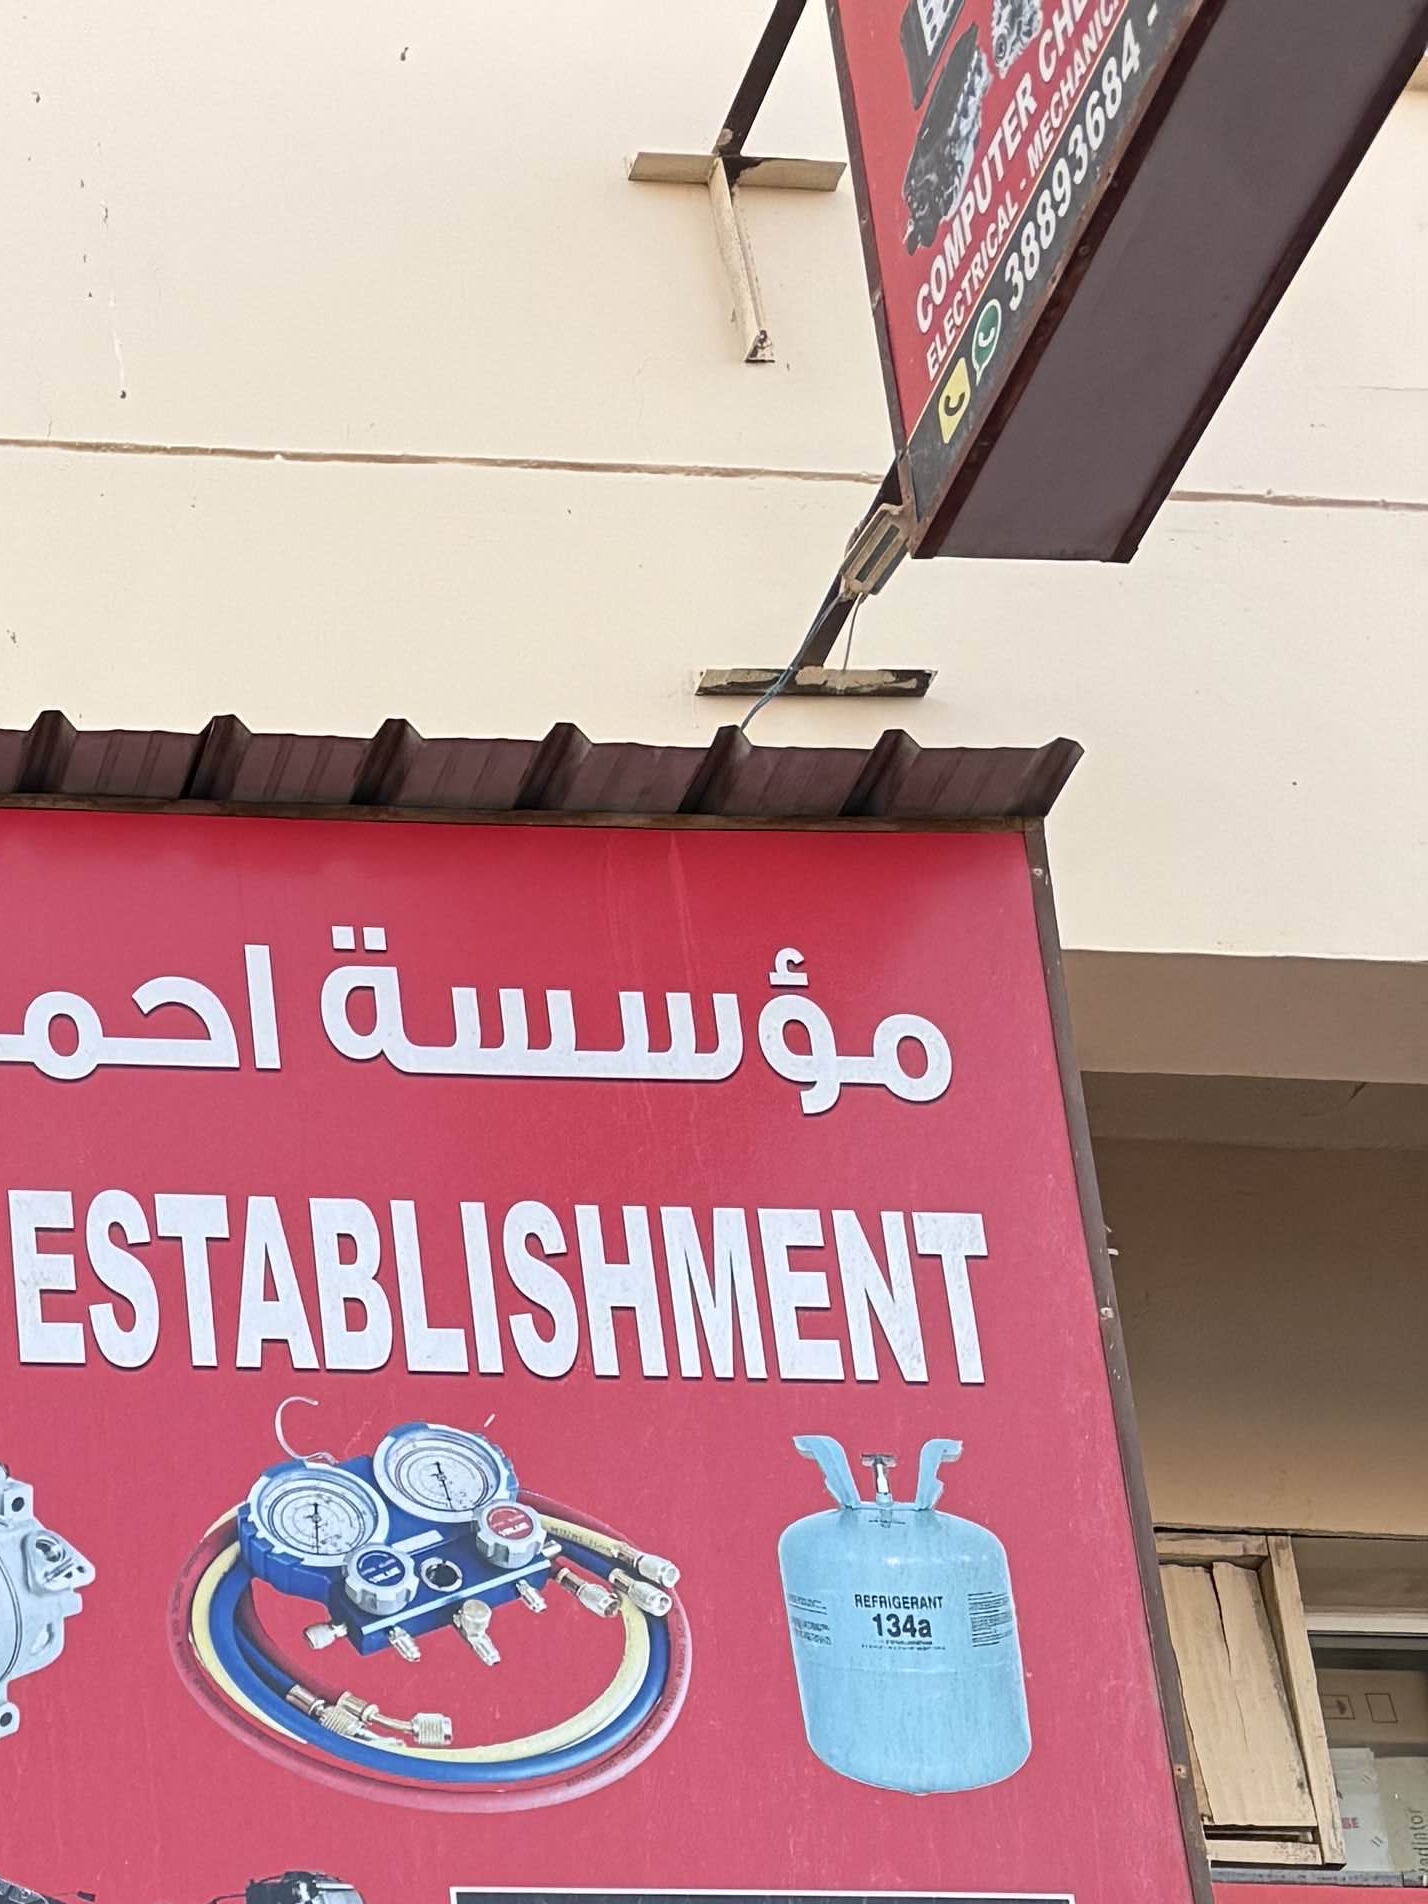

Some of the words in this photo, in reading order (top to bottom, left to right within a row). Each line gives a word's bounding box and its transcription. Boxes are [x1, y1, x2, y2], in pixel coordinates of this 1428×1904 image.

[916, 72, 1038, 335] COMPUTER
[925, 191, 1020, 382] ELECTRICAL
[1026, 0, 1119, 178] MECHANIC
[1004, 18, 1142, 312] 38893684
[321, 925, 955, 1116] مؤسسة
[7, 1188, 991, 1388] ESTABLISHMENT
[854, 1593, 944, 1610] REFRIGERANT
[872, 1612, 932, 1639] 134a
